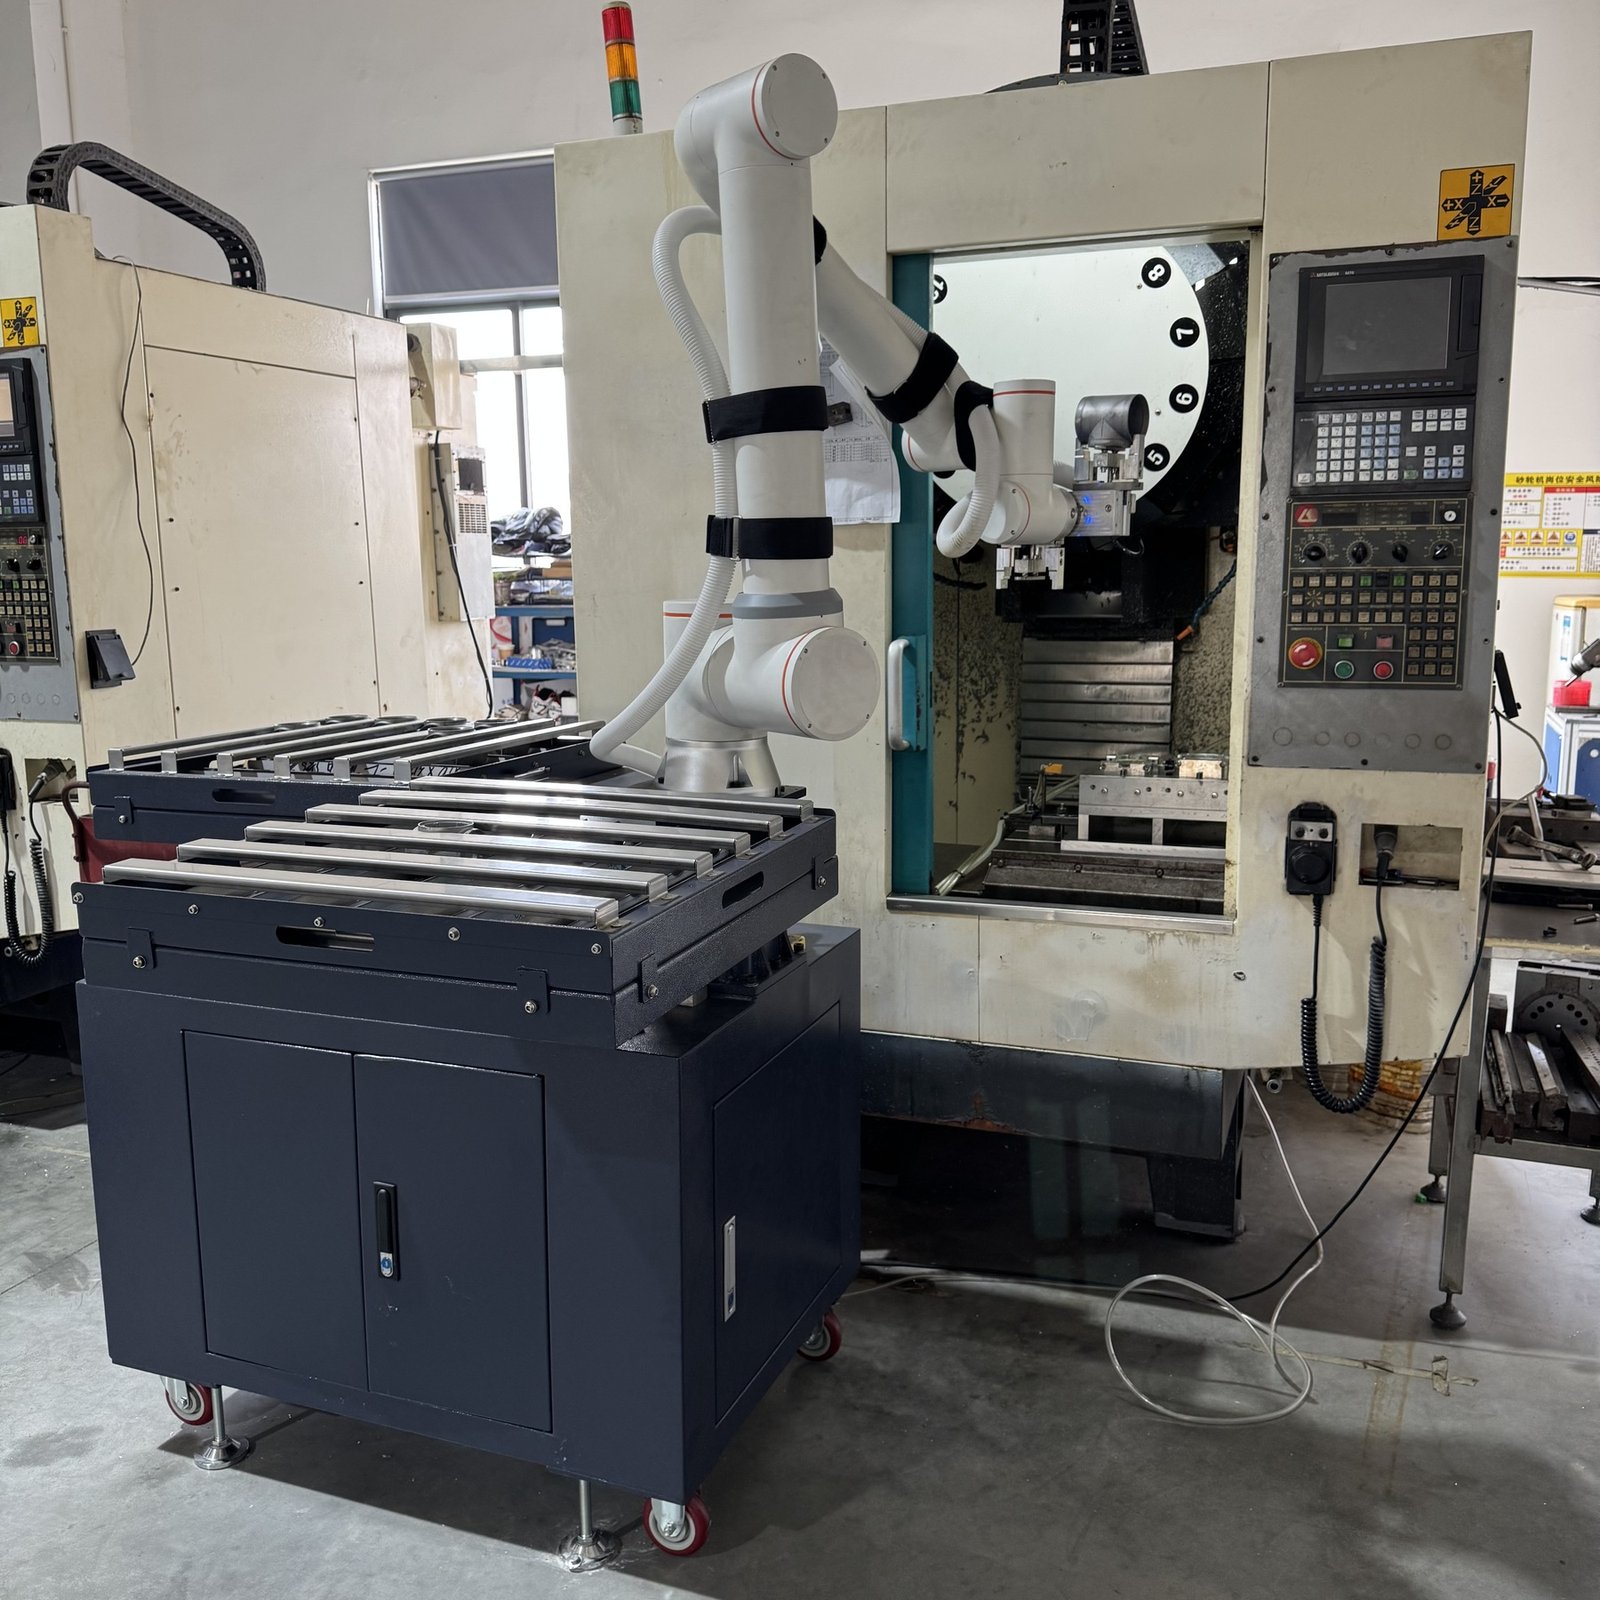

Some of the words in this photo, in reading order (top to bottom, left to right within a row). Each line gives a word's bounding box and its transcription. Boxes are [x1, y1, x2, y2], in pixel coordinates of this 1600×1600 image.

[1147, 263, 1166, 282] 8
[1175, 327, 1194, 341] 7
[1175, 391, 1193, 406] 6
[1147, 449, 1164, 466] 5
